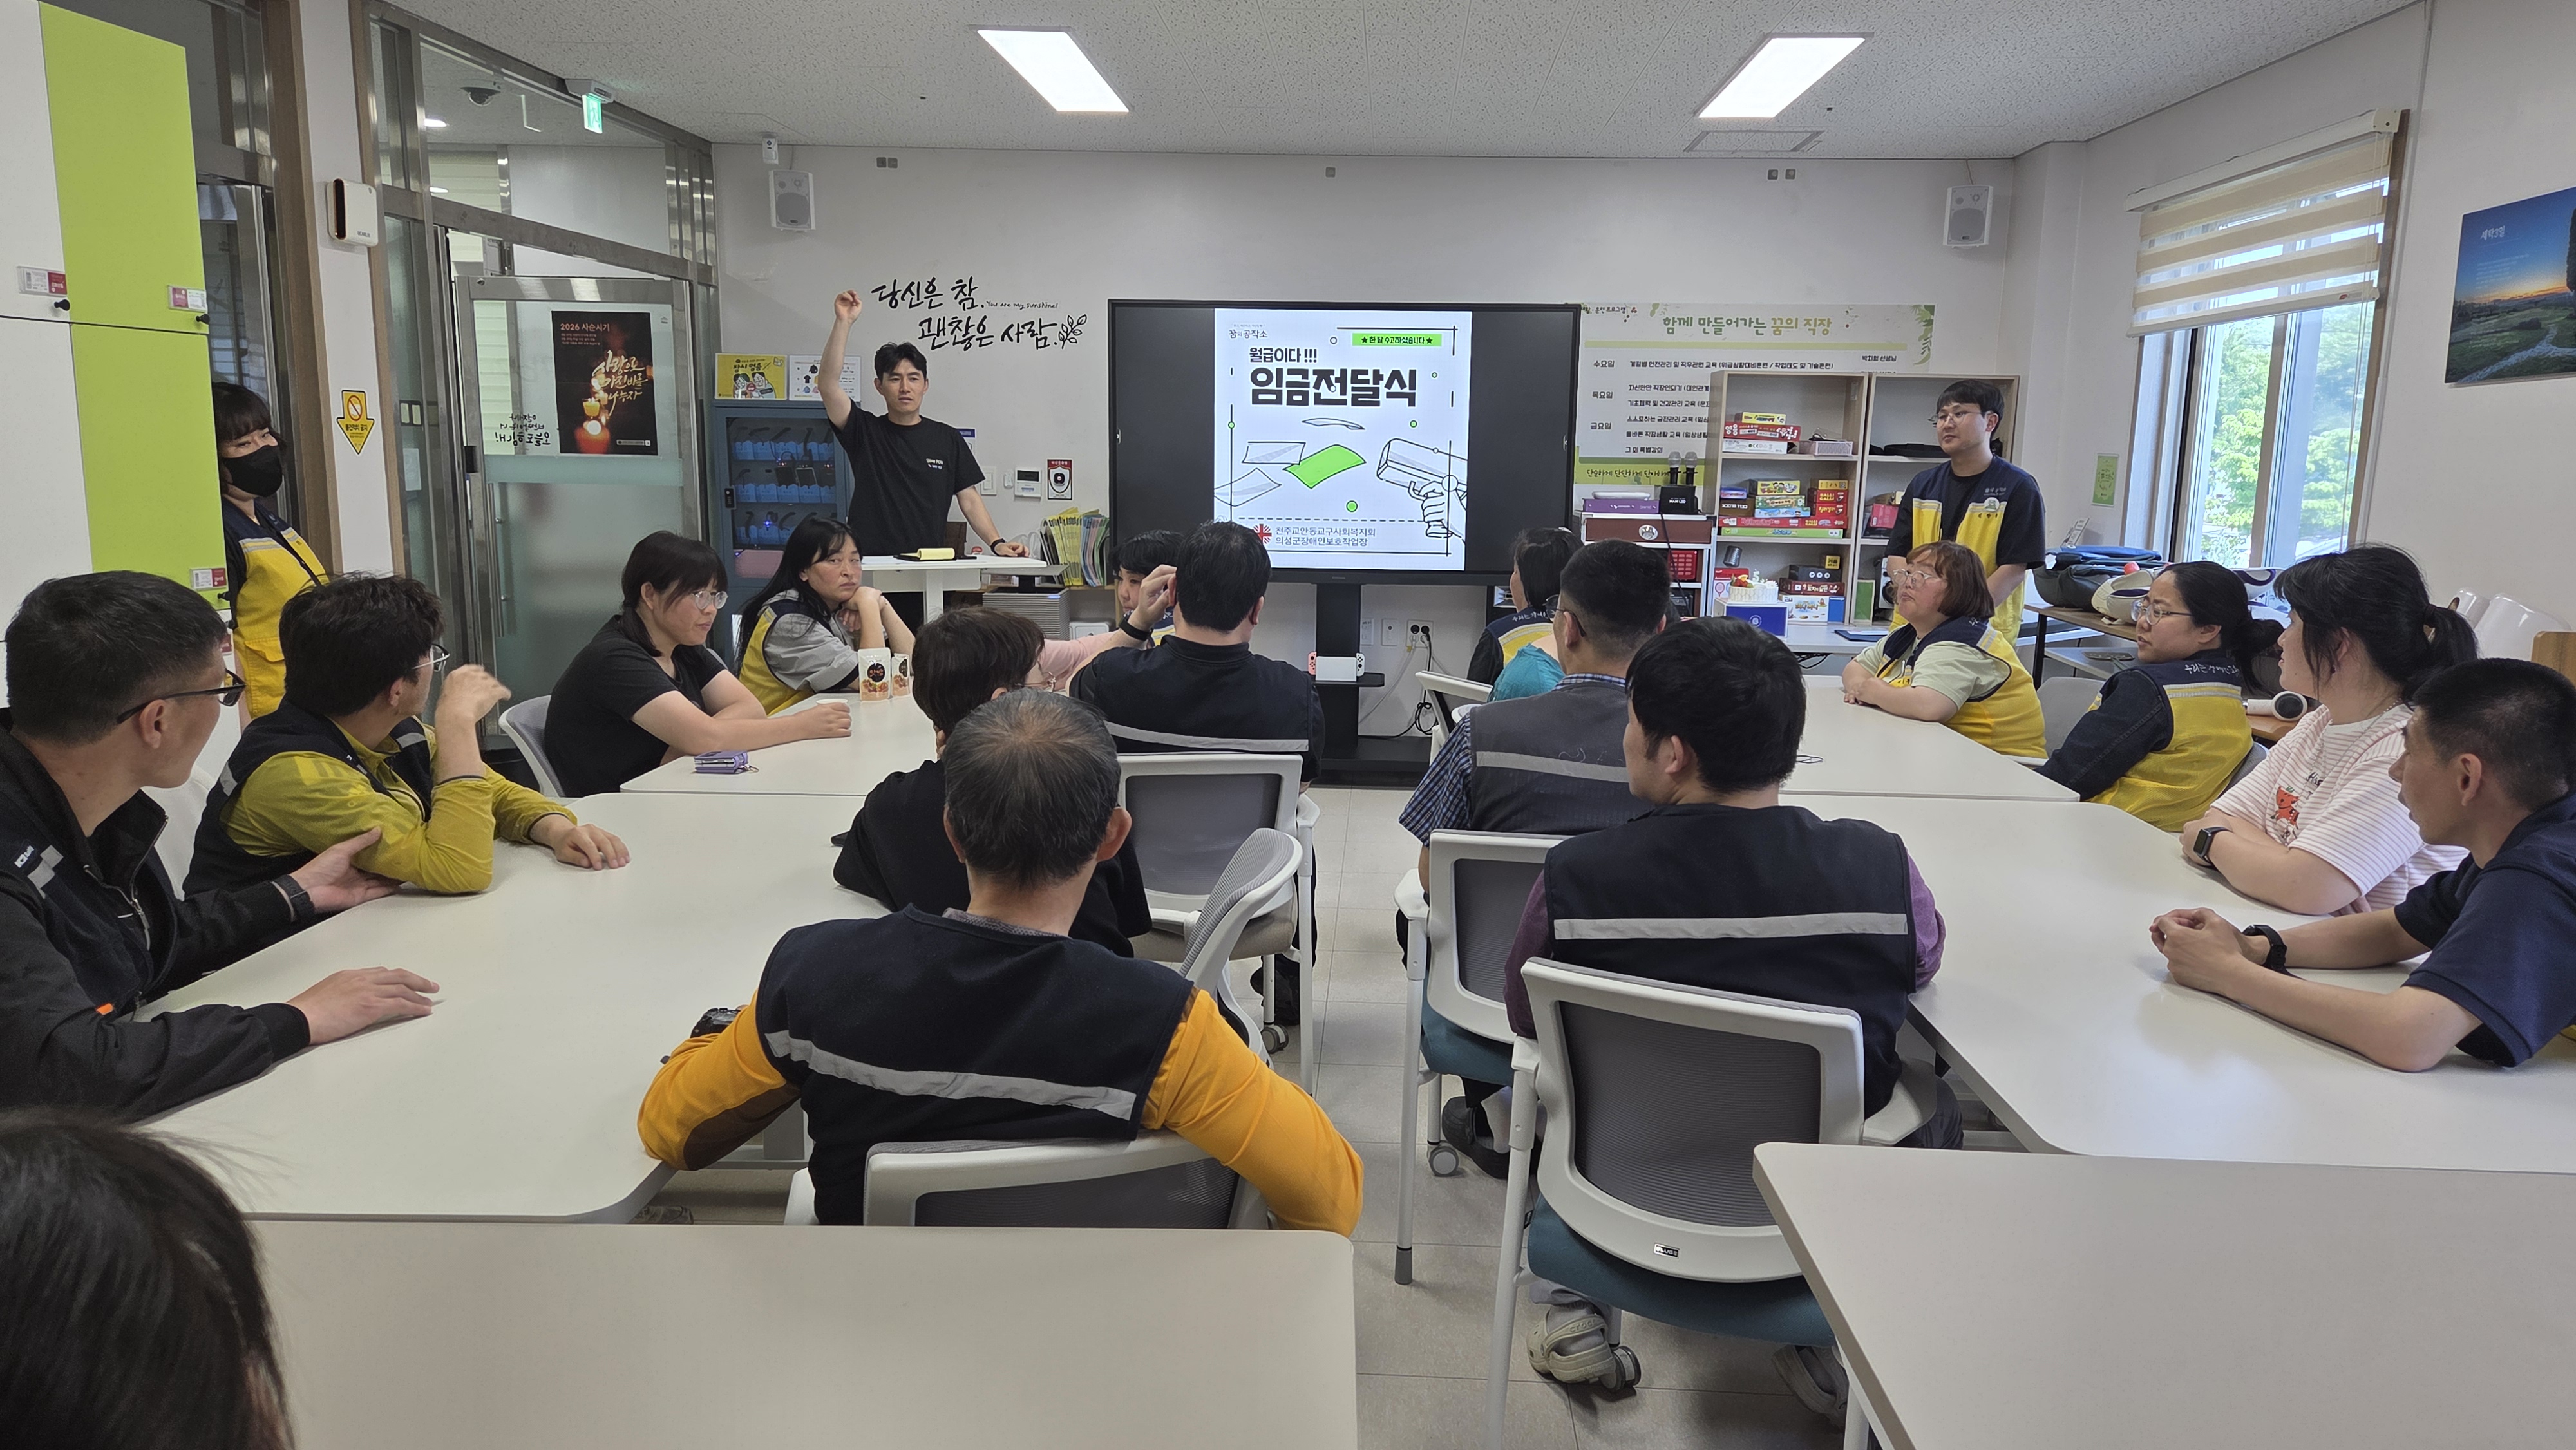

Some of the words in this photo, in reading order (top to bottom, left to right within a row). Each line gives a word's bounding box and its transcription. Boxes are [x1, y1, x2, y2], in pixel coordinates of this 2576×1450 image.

[871, 277, 943, 309] 당신은
[951, 276, 985, 311] 참.
[582, 323, 610, 332] 사순시기
[1663, 316, 1693, 335] 함께
[1698, 317, 1766, 336] 만들어가는
[1771, 317, 1799, 336] 꿈의
[1803, 317, 1833, 336] 직장
[918, 315, 994, 351] 괜찮은
[1001, 318, 1057, 350] 사람.
[1249, 348, 1302, 362] 월급이다
[1304, 348, 1317, 362] !!!
[1250, 367, 1417, 407] 임금전달식
[1592, 391, 1613, 399] 목요일
[1591, 422, 1611, 430] 금요일
[1276, 527, 1376, 537] 천주교안동교구사회복지회
[1276, 536, 1368, 547] 의성군장애인보호작업장
